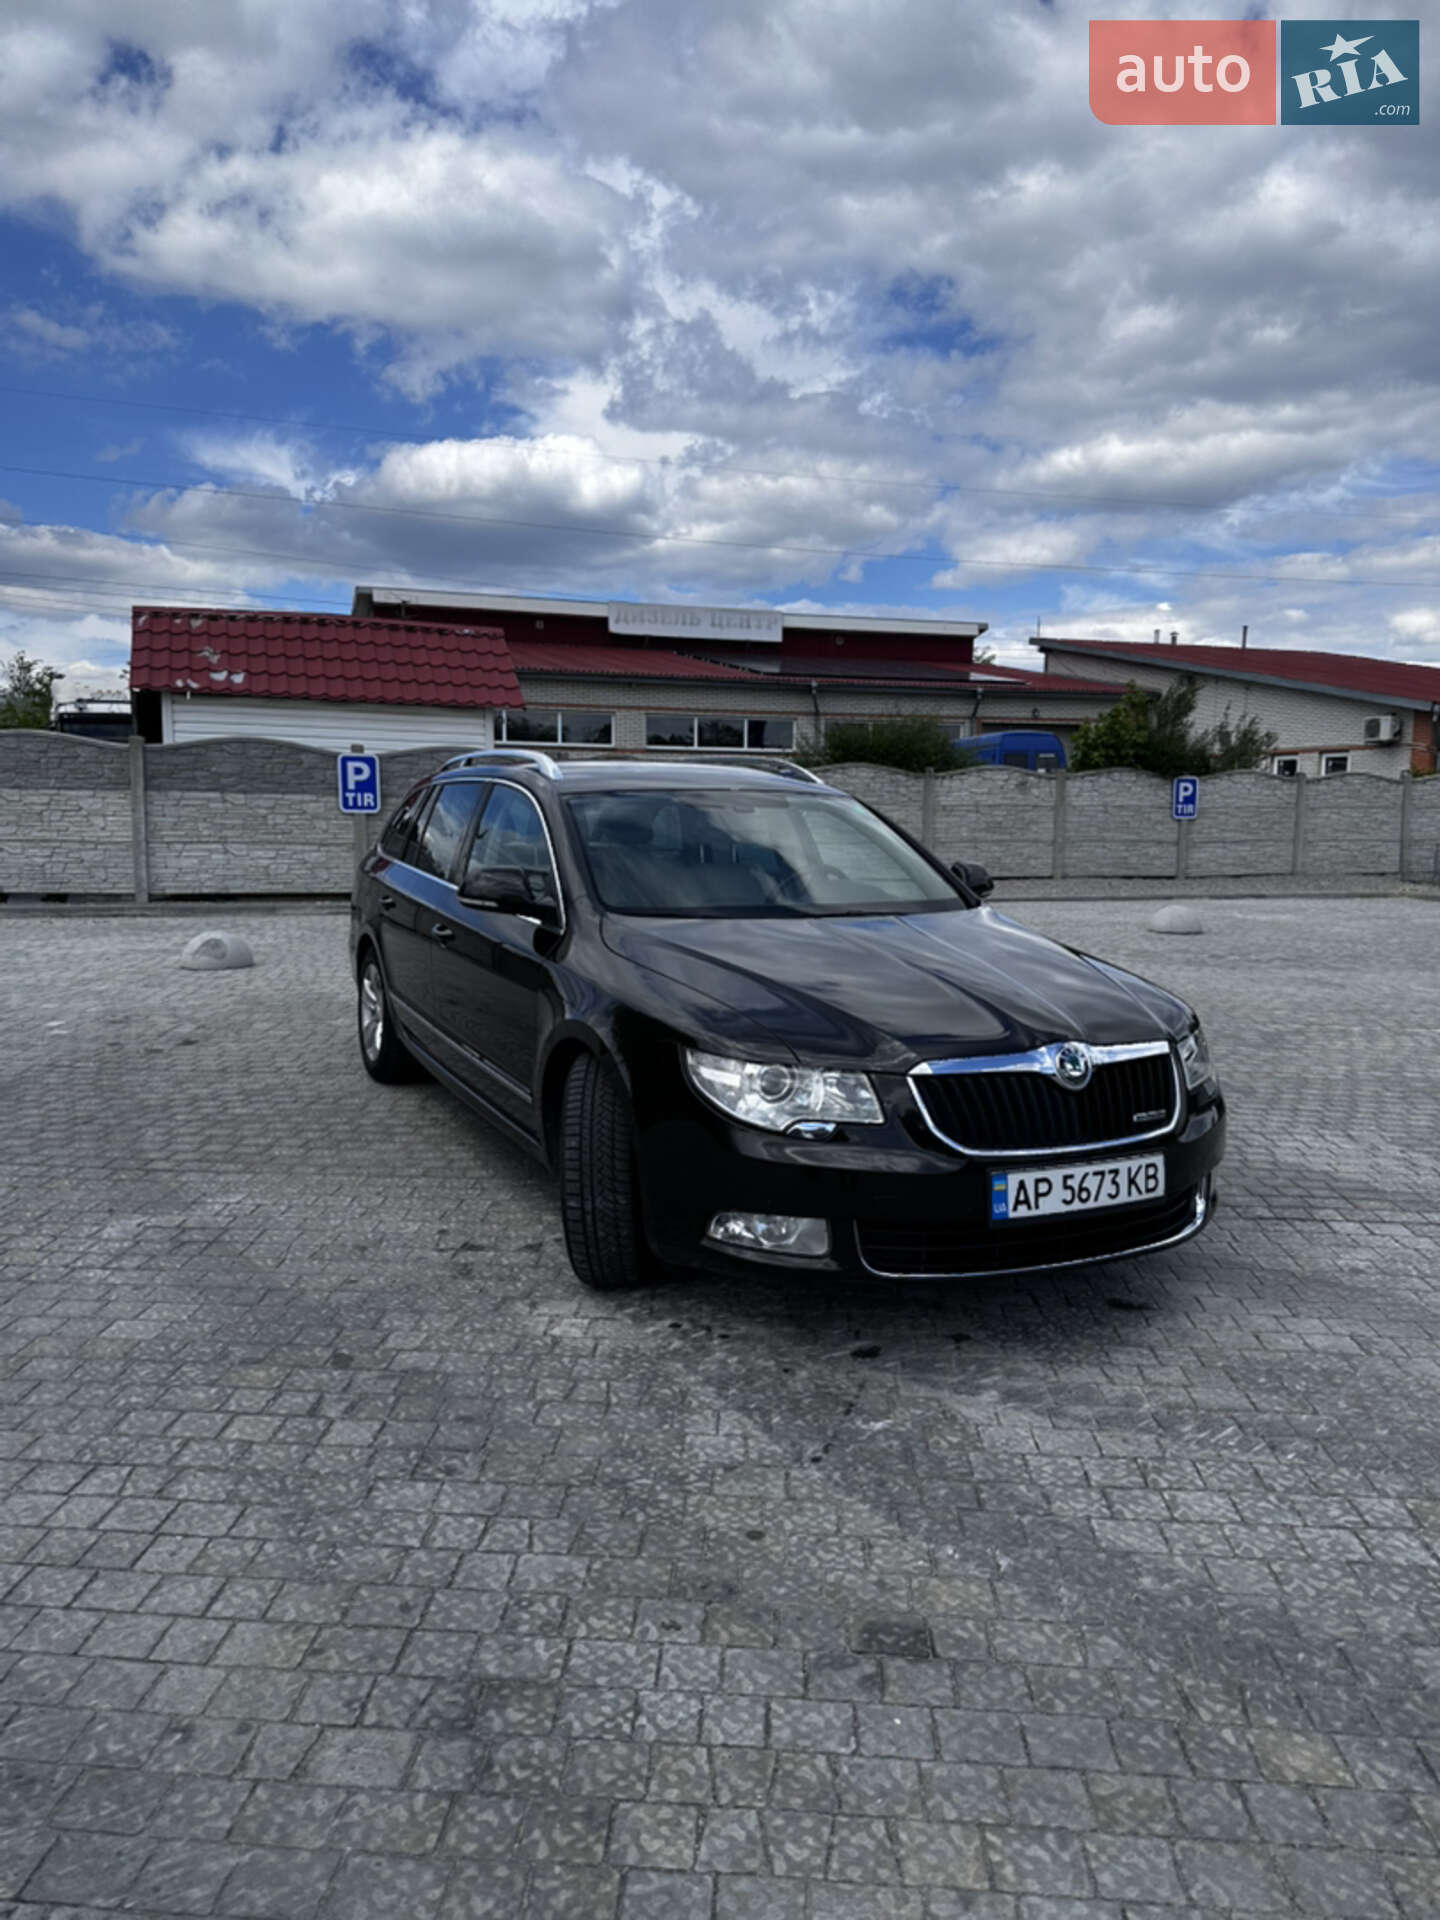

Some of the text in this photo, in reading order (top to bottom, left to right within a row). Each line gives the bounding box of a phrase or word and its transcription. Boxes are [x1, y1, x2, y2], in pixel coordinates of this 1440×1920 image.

[346, 761, 371, 790] P
[345, 792, 375, 807] TIR
[1179, 782, 1194, 802] P
[1176, 804, 1194, 814] TIR
[1012, 1162, 1160, 1212] AP 5673 KB
[993, 1203, 1007, 1213] UA
